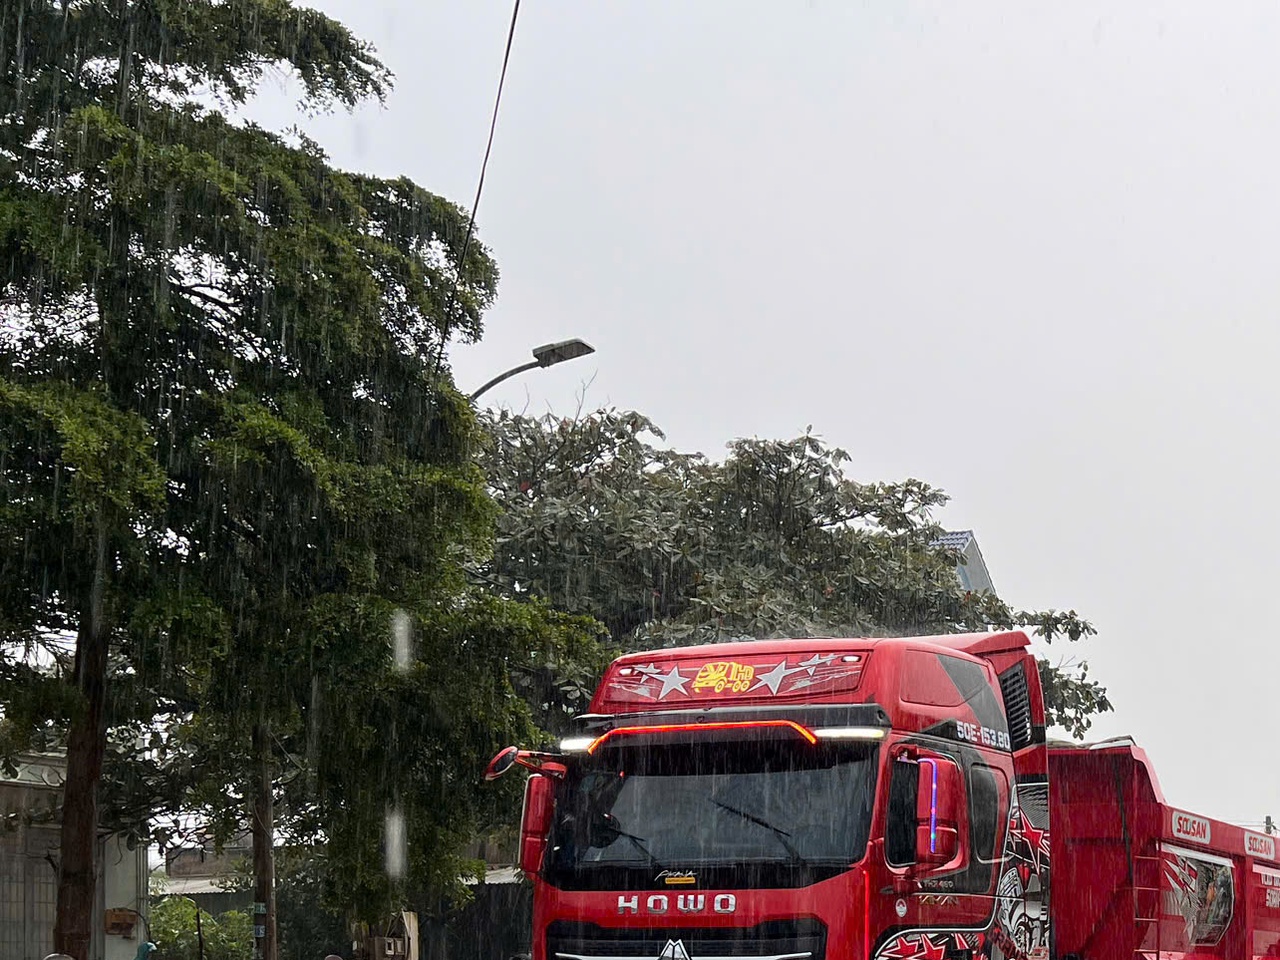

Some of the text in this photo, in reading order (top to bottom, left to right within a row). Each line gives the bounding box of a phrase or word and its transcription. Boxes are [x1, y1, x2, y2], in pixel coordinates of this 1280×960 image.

[956, 720, 1011, 750] 50E-153.80
[1176, 816, 1207, 839] SOOSAN
[618, 893, 736, 915] HOWO
